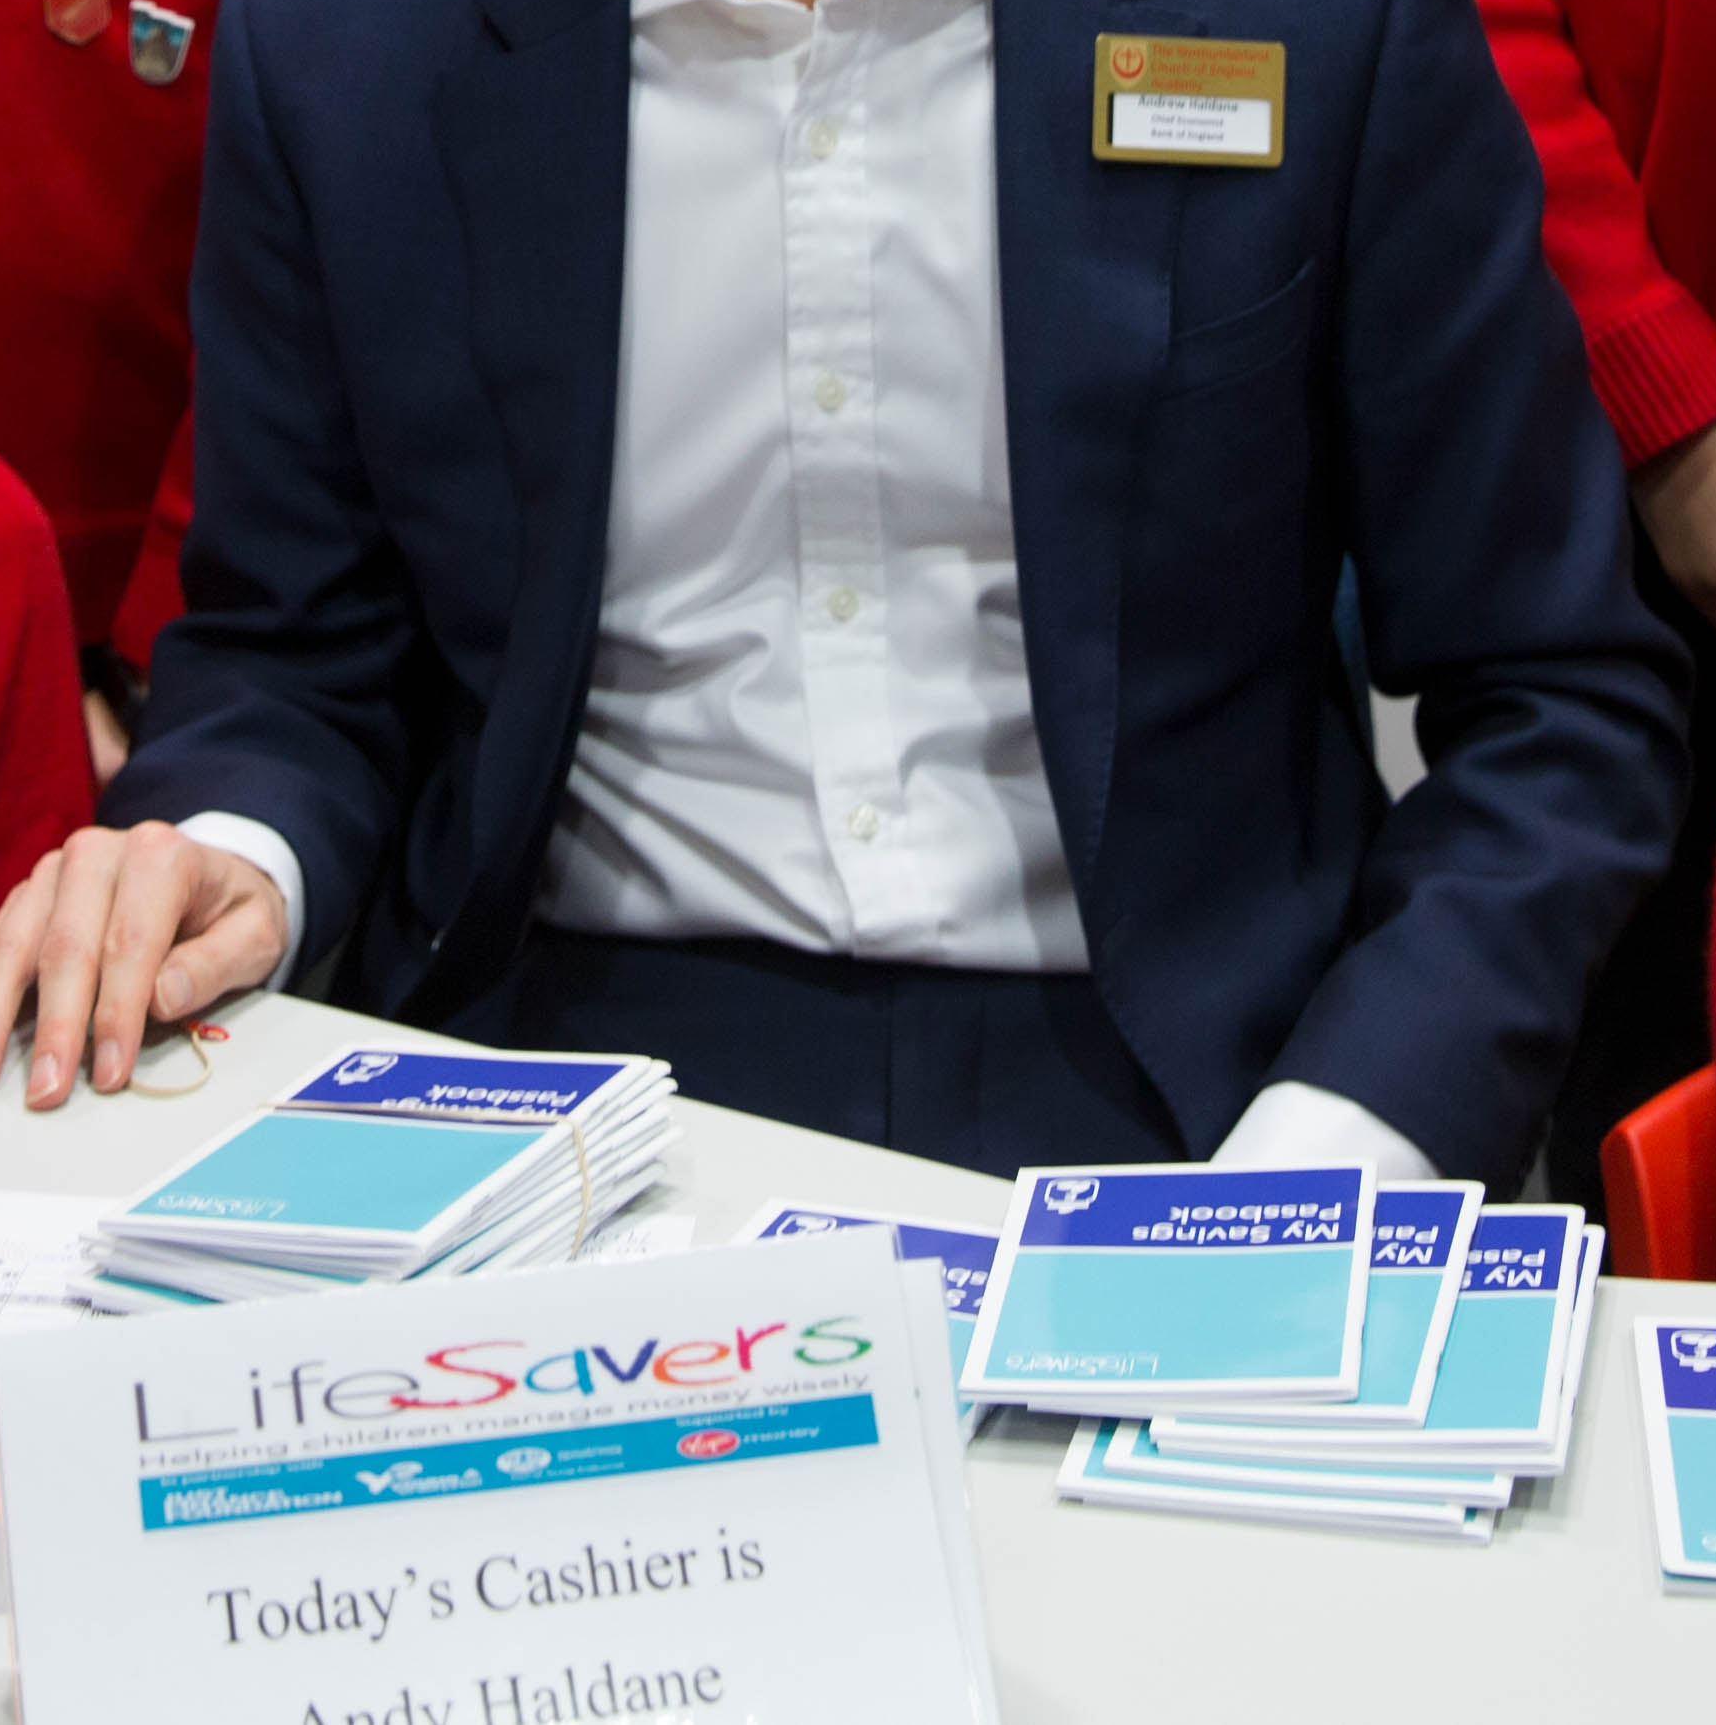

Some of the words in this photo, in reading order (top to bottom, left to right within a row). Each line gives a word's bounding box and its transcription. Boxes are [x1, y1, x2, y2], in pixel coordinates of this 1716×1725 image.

[1138, 94, 1185, 109] Andrew
[1189, 97, 1239, 113] Haldane
[425, 1083, 579, 1108] Passbook
[1168, 1202, 1342, 1225] Passbook
[1132, 1221, 1271, 1245] Savings
[1282, 1219, 1340, 1243] My
[1374, 1241, 1433, 1265] My
[1467, 1248, 1545, 1267] Pass
[1484, 1265, 1542, 1288] My
[134, 1315, 873, 1443] LifeSavers
[139, 1442, 288, 1471] Helping
[301, 1420, 452, 1451] children
[464, 1401, 615, 1435] manage
[627, 1387, 751, 1414] money
[761, 1371, 870, 1399] wisely
[473, 1536, 699, 1614] Cashier
[716, 1526, 766, 1583] is
[475, 1661, 726, 1725] Haldane
